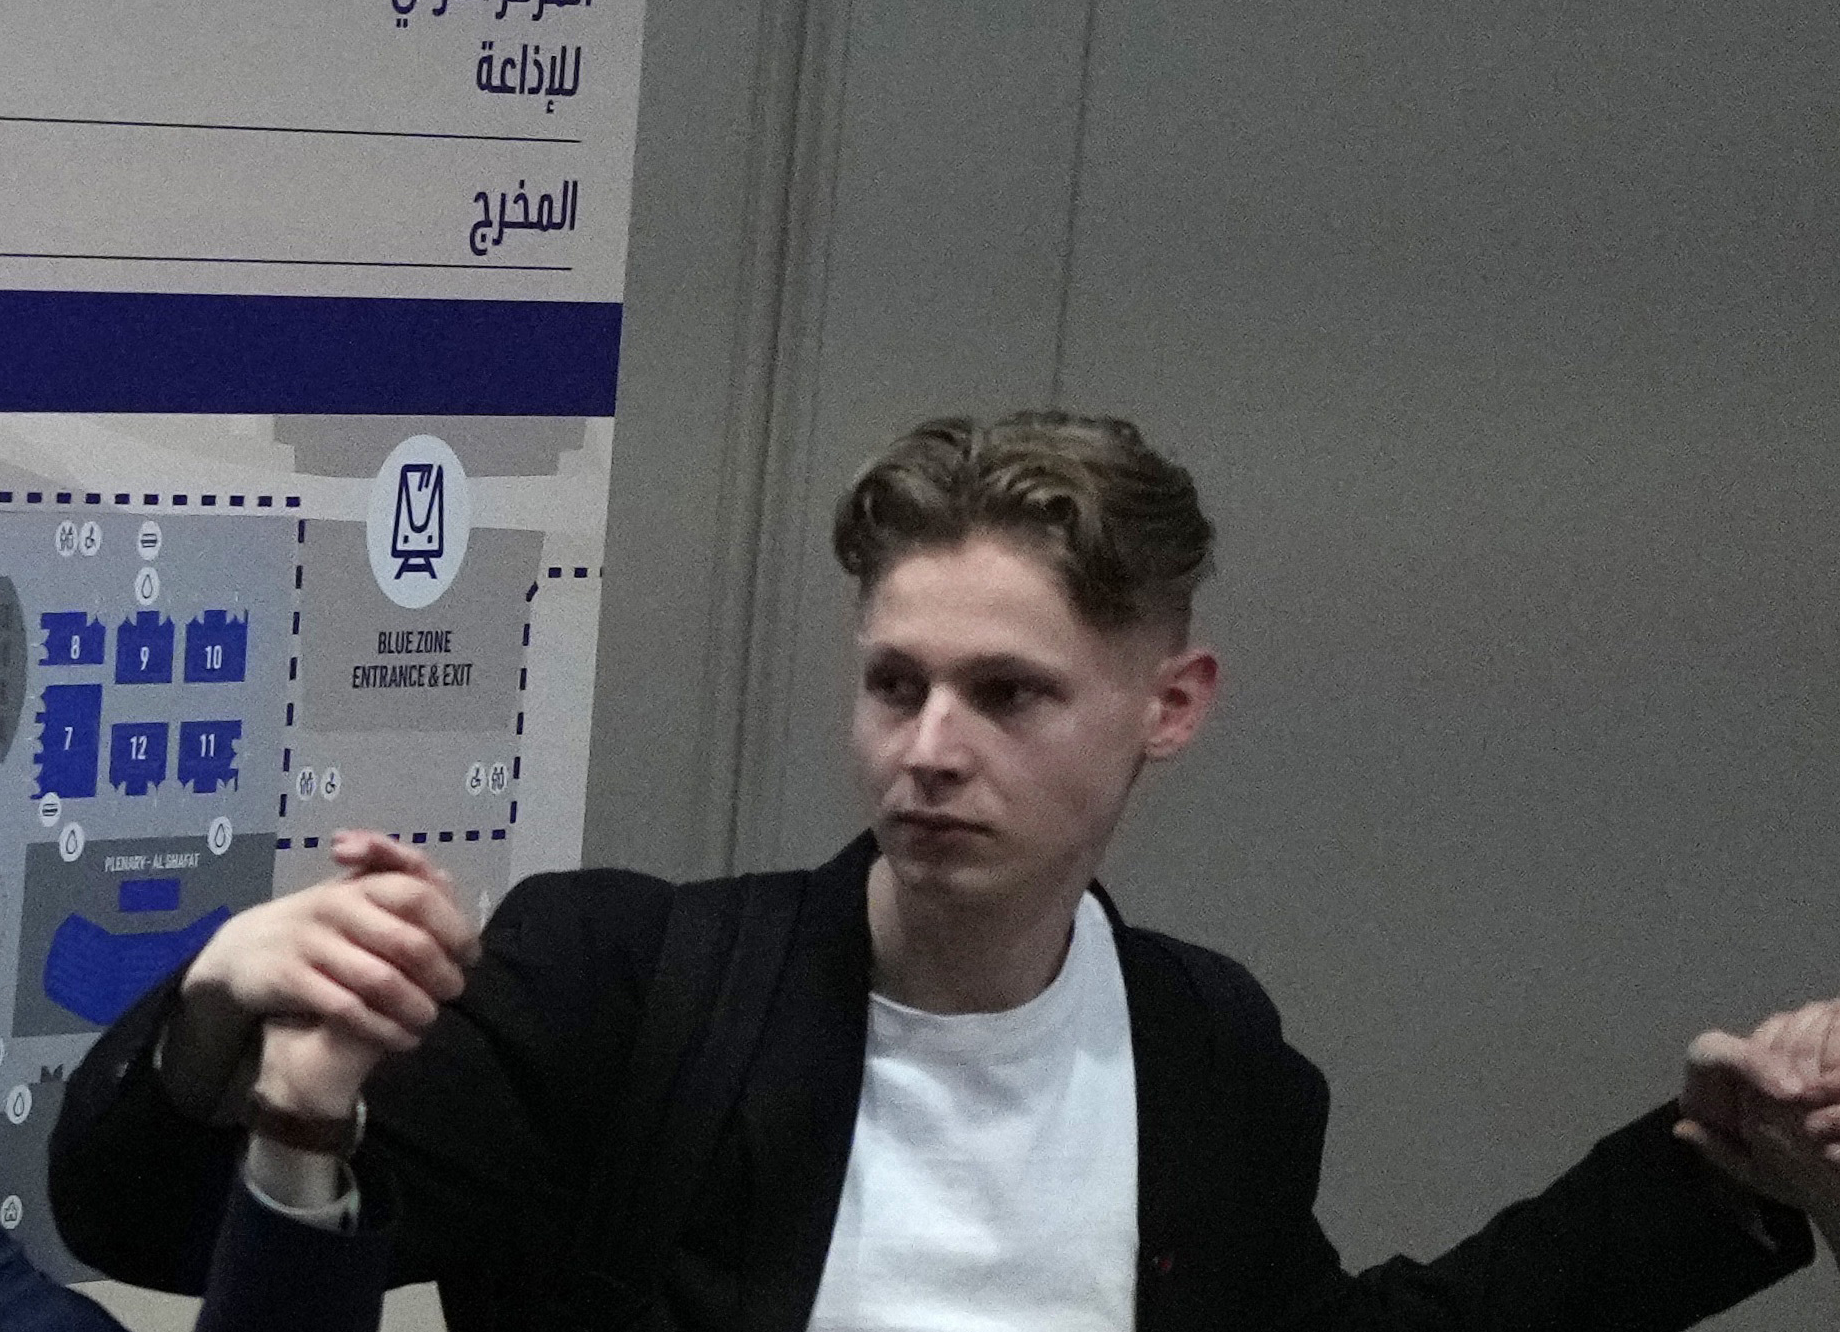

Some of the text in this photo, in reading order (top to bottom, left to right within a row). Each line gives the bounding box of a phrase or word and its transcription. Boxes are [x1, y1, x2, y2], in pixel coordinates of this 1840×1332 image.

[476, 40, 582, 114] للإذاعة
[469, 179, 579, 257] المخرج
[70, 635, 80, 659] 8
[377, 630, 453, 654] BLUE ZONE
[140, 647, 150, 670] 9
[205, 645, 223, 669] 10
[351, 663, 473, 688] ENTRANCE & EXIT
[64, 726, 74, 750] 7
[130, 735, 148, 760] 12
[199, 733, 215, 757] 11
